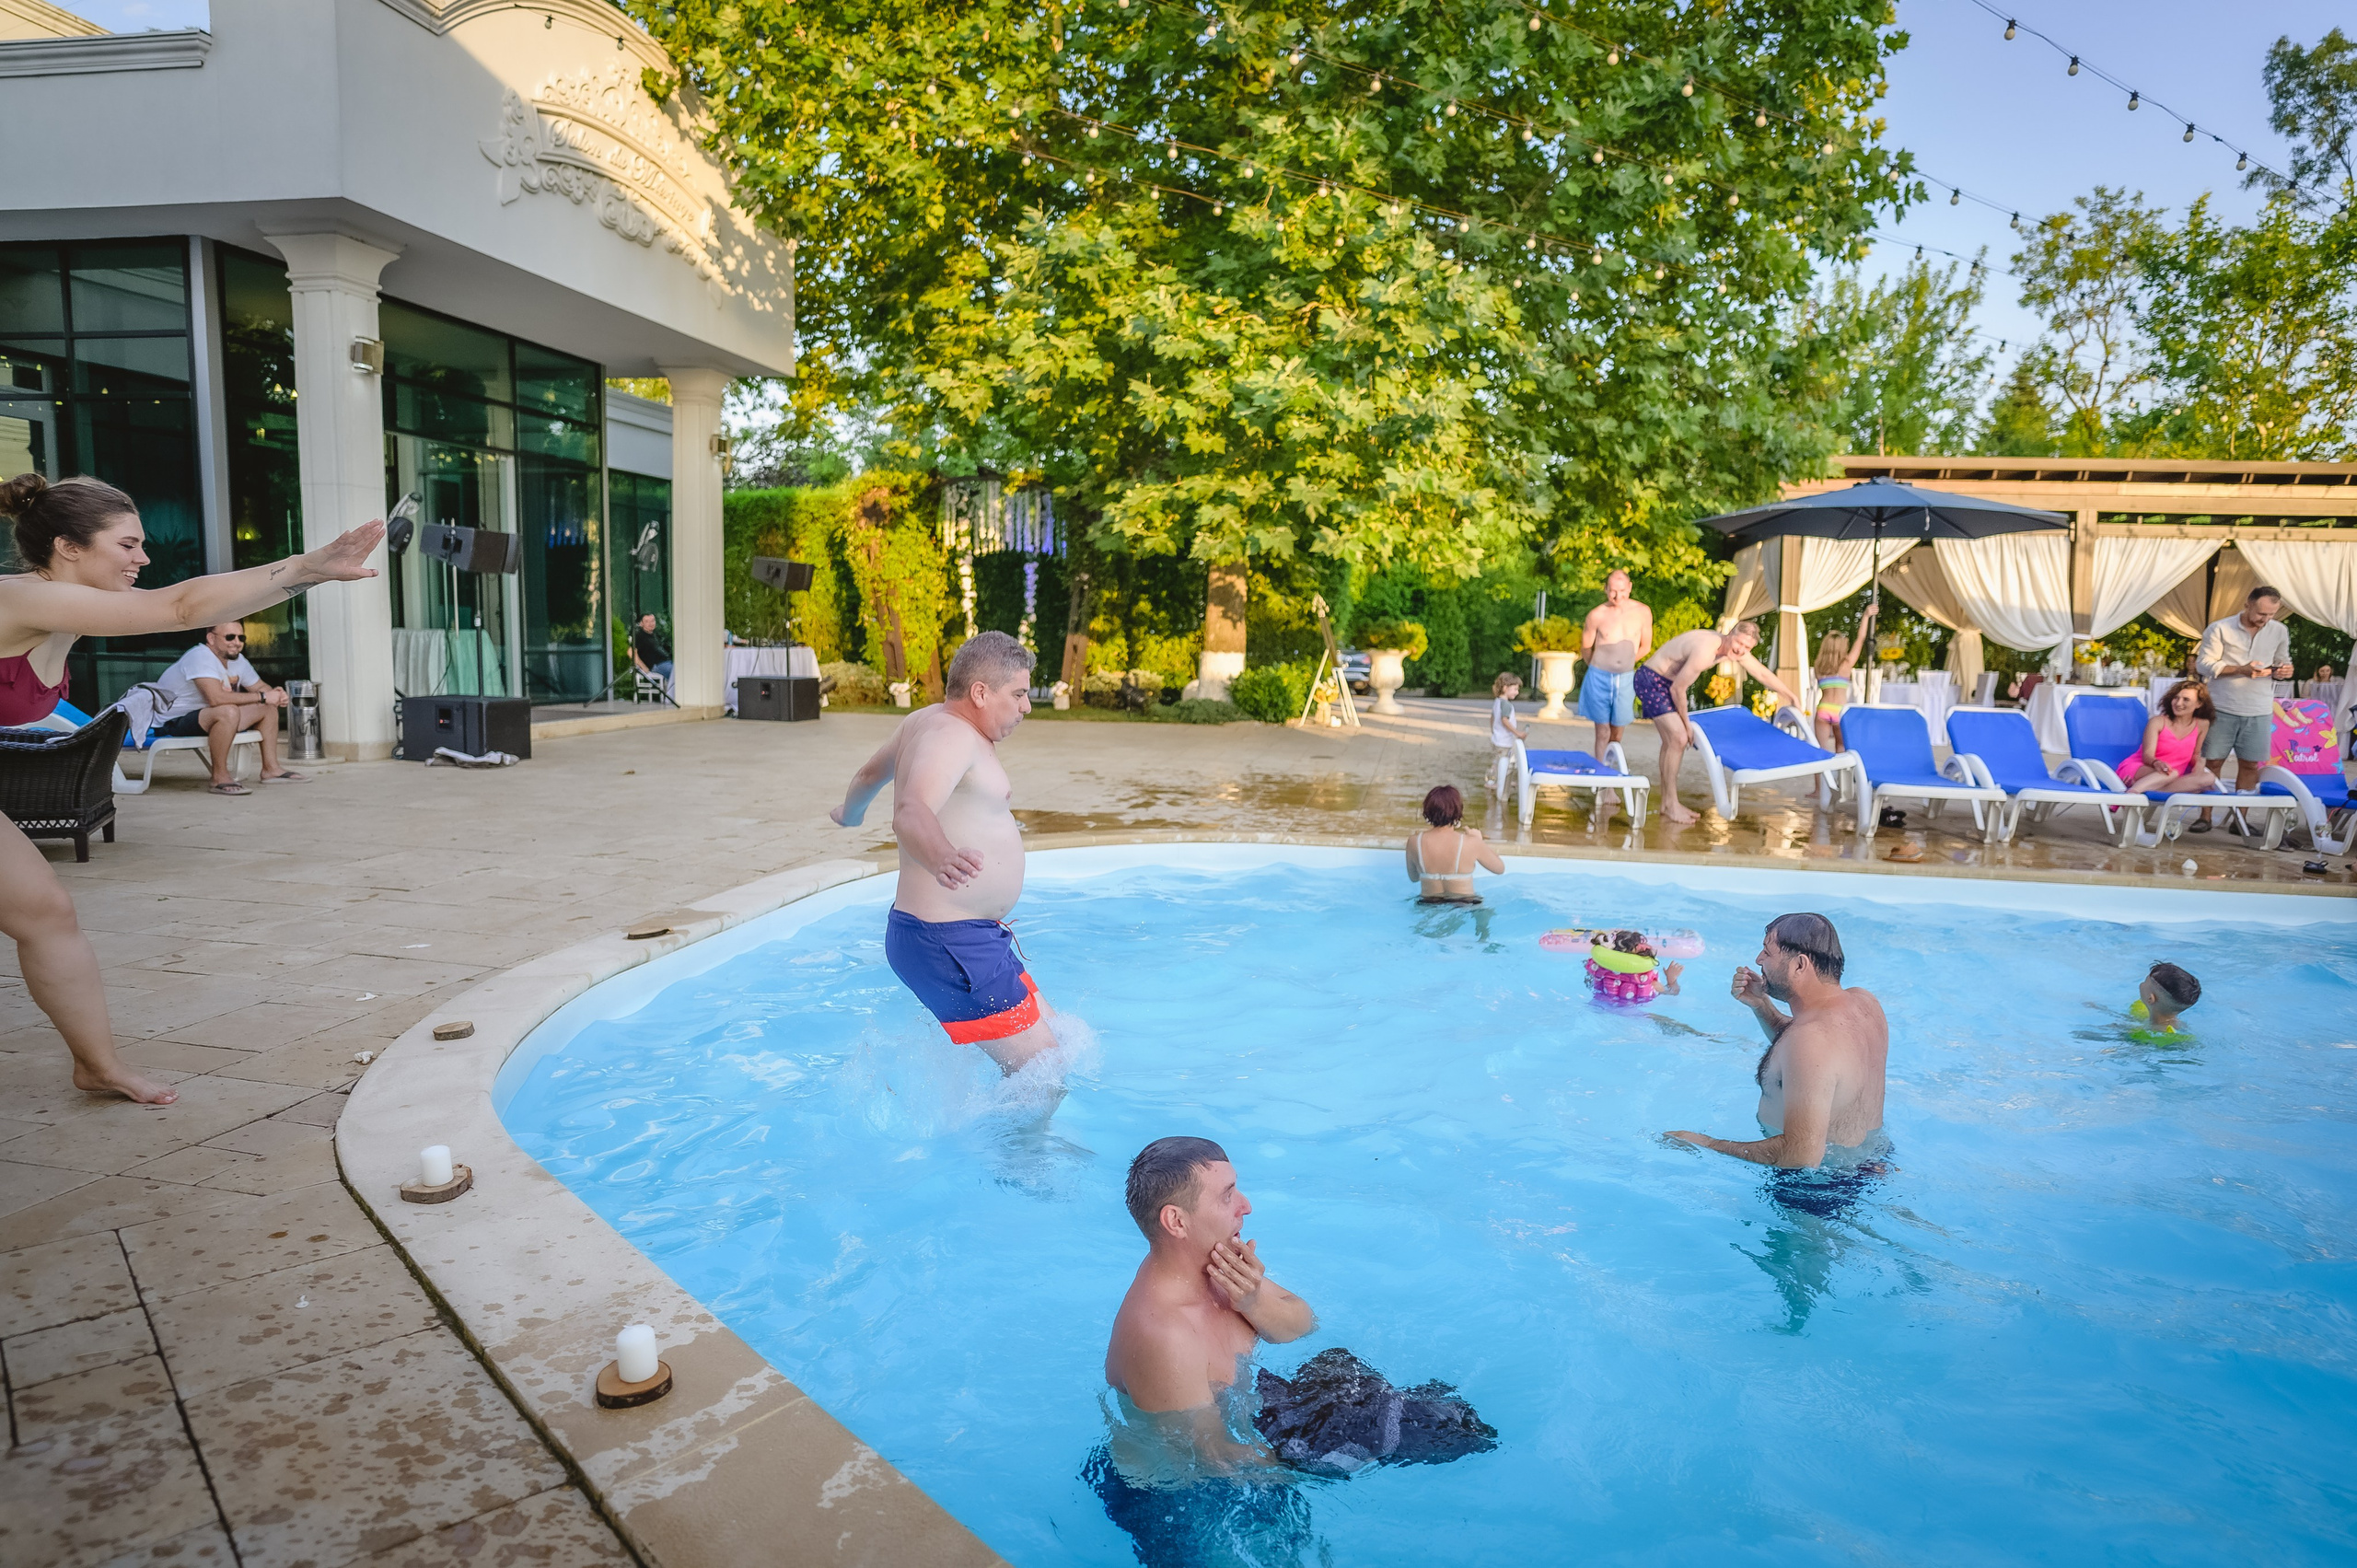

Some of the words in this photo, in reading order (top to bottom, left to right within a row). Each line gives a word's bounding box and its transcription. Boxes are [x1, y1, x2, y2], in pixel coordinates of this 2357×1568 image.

[548, 118, 601, 158] Salon
[269, 565, 287, 581] forever
[2283, 749, 2319, 762] Patrol
